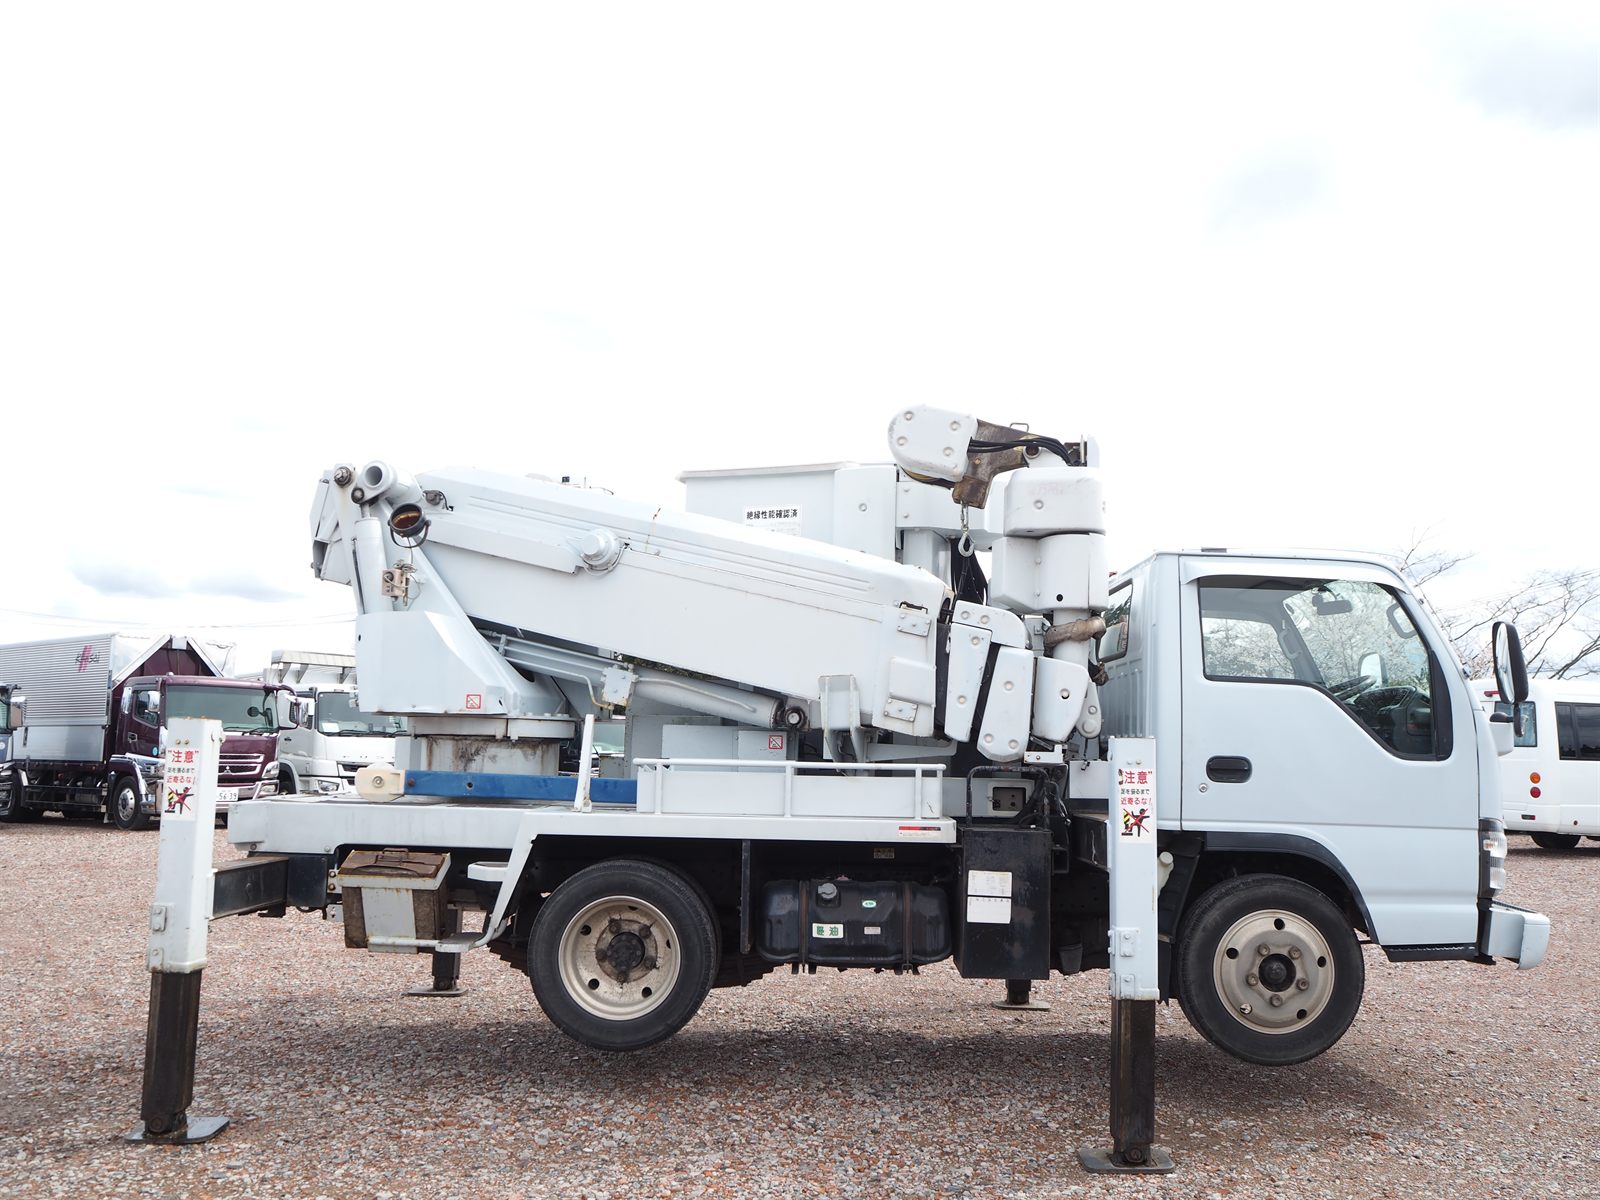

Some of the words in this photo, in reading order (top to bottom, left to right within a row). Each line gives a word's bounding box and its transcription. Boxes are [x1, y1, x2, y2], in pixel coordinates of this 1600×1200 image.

[746, 509, 798, 520] 絶縁性能確認済
[816, 925, 839, 936] 軽油
